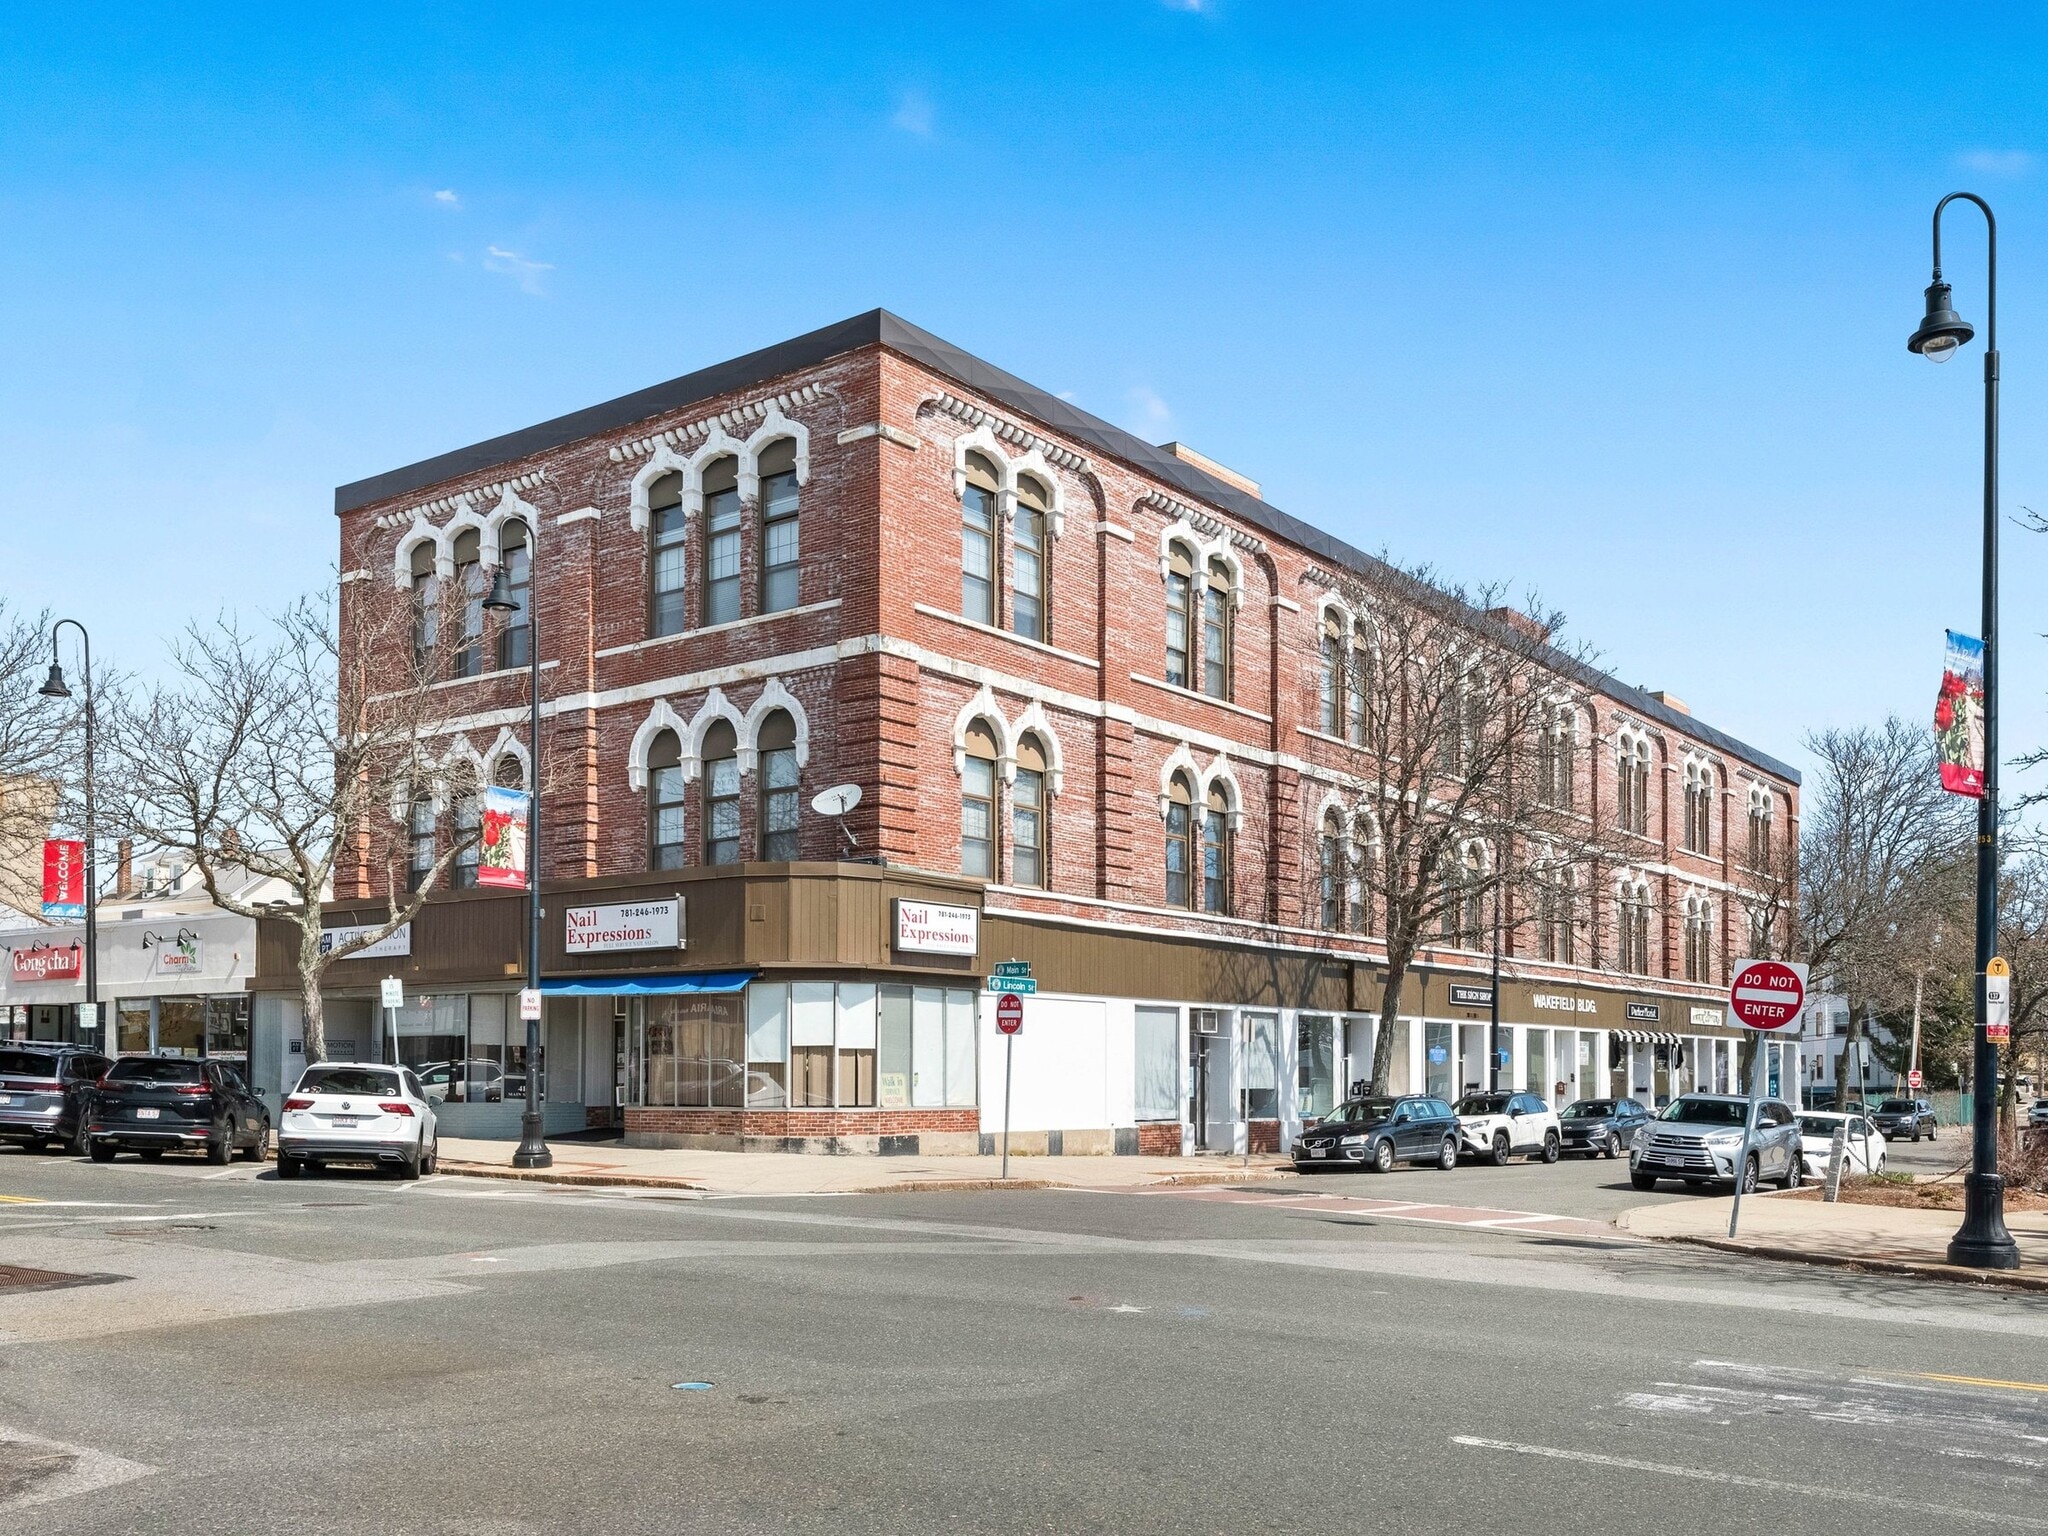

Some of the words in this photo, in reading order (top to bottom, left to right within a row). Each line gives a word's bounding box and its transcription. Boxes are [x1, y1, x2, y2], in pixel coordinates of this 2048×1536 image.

[620, 906, 669, 917] 781-246-1973
[901, 907, 928, 924] Nail
[938, 910, 971, 920] 781-246-1973
[568, 910, 597, 928] Nail
[567, 924, 652, 948] Expressions
[900, 924, 975, 945] Expressions
[14, 953, 47, 977] Gong
[47, 950, 69, 970] cha
[164, 953, 189, 964] Charm
[1006, 965, 1020, 975] Main
[1003, 980, 1026, 990] Lincoln
[1744, 973, 1762, 986] DO
[1769, 976, 1795, 988] NOT
[1000, 1000, 1008, 1008] DO
[1533, 994, 1575, 1011] WAKEFIELD
[1577, 998, 1598, 1013] BLDG.
[1744, 1004, 1785, 1018] ENTER
